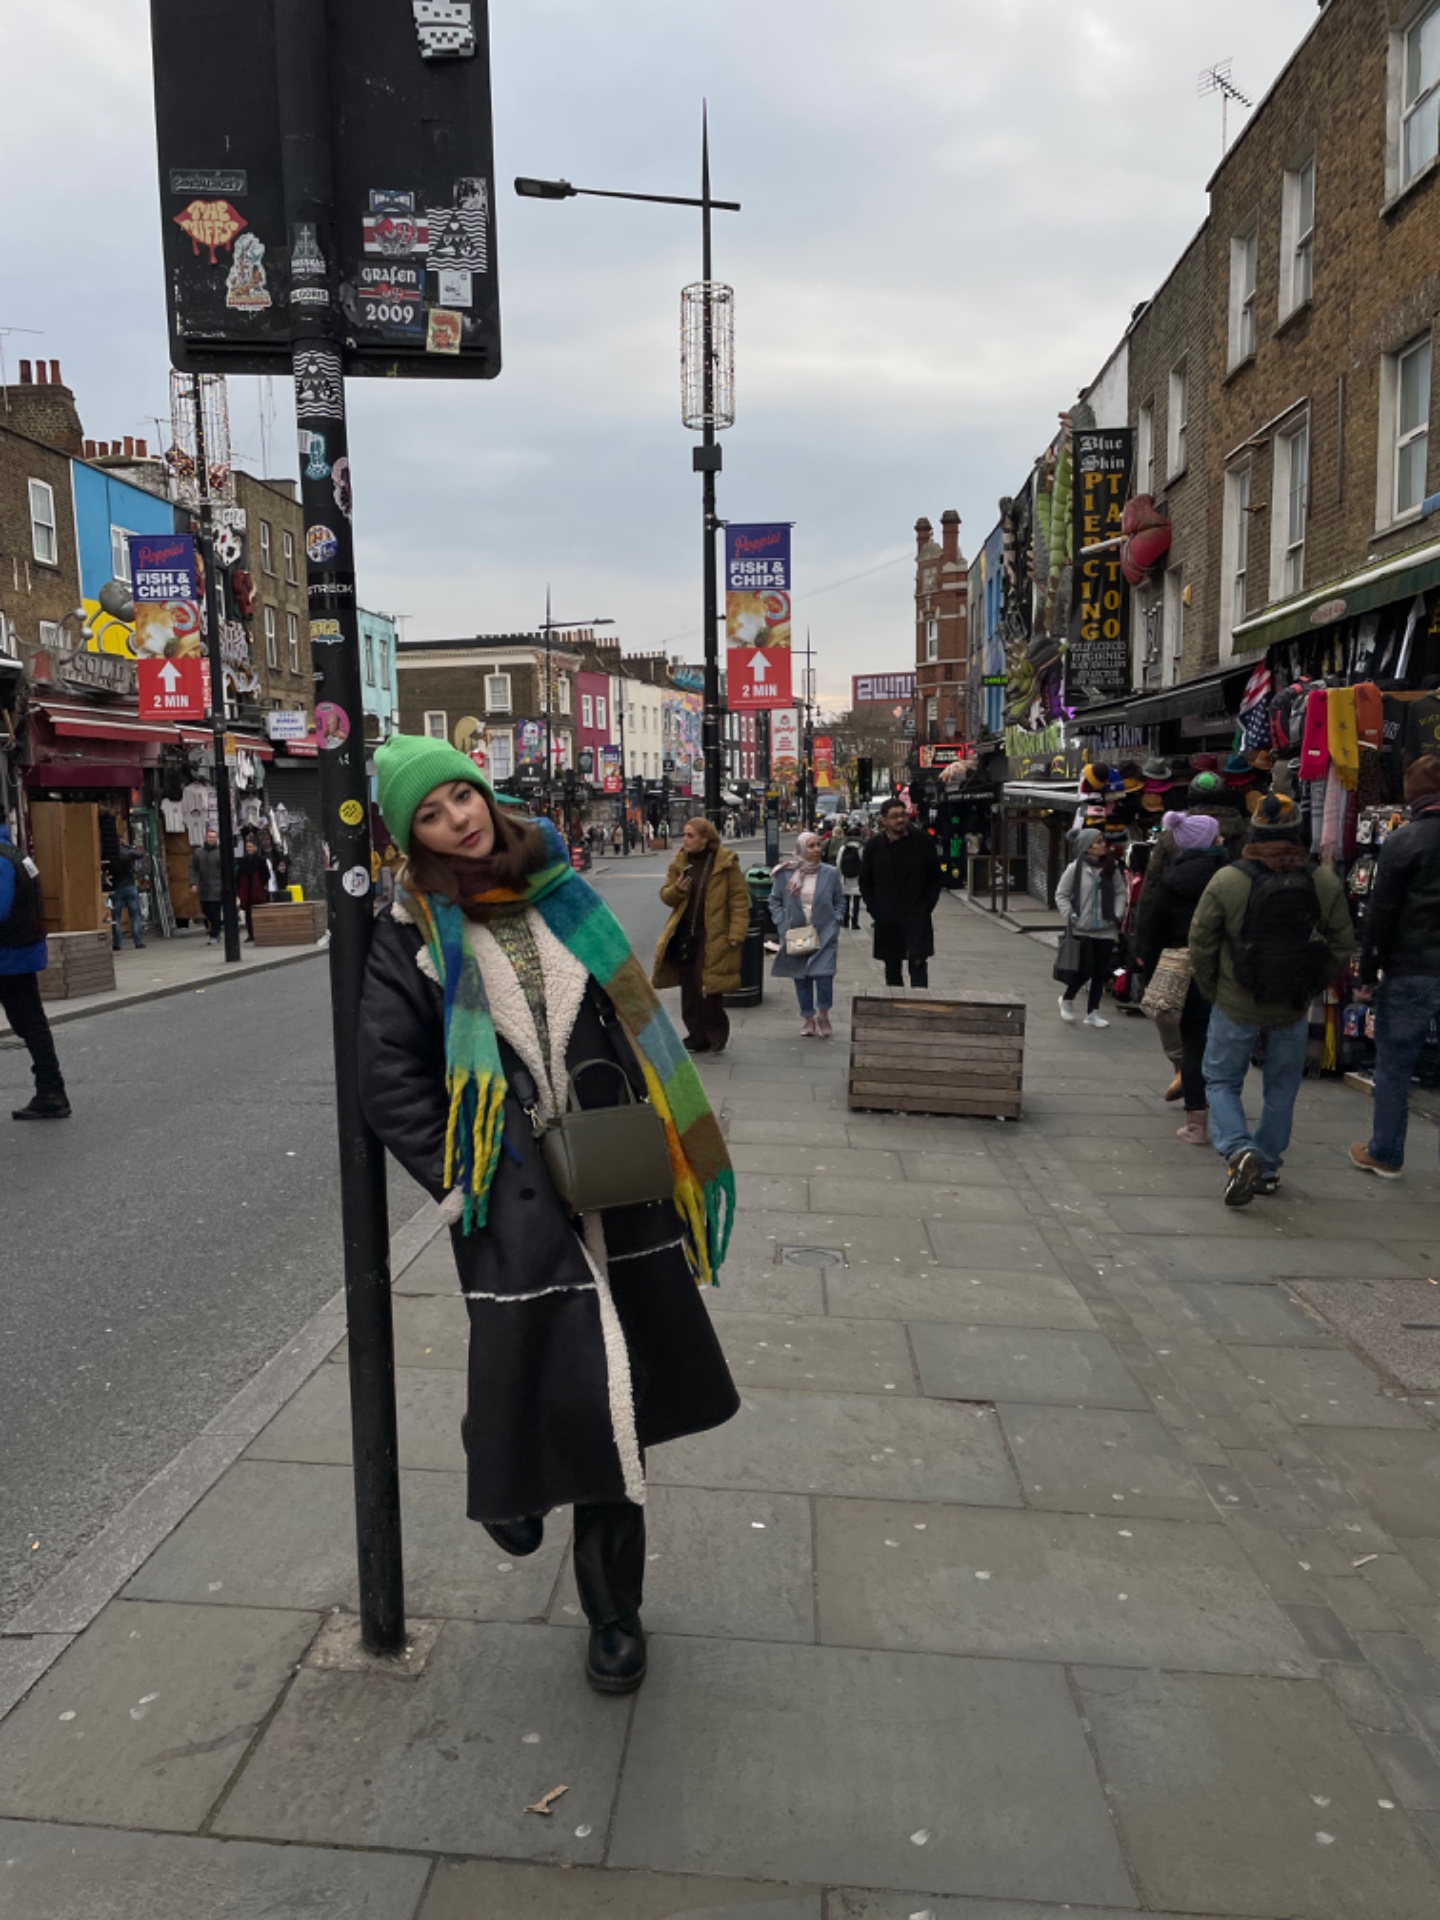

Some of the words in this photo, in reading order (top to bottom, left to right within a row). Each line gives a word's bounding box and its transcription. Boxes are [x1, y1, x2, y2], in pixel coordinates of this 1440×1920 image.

[186, 200, 231, 221] THE
[365, 303, 414, 324] 2009
[1079, 435, 1123, 452] Blue
[1079, 454, 1125, 473] Skin
[1103, 474, 1122, 639] TATTOO
[730, 561, 768, 574] FISH
[771, 561, 785, 574] &
[136, 573, 173, 585] FISH
[177, 573, 190, 585] &
[731, 575, 785, 586] CHIPS
[138, 585, 191, 597] CHIPS
[742, 685, 750, 697] 2
[753, 685, 778, 697] MIN
[153, 695, 162, 707] 2
[165, 695, 189, 707] MIN
